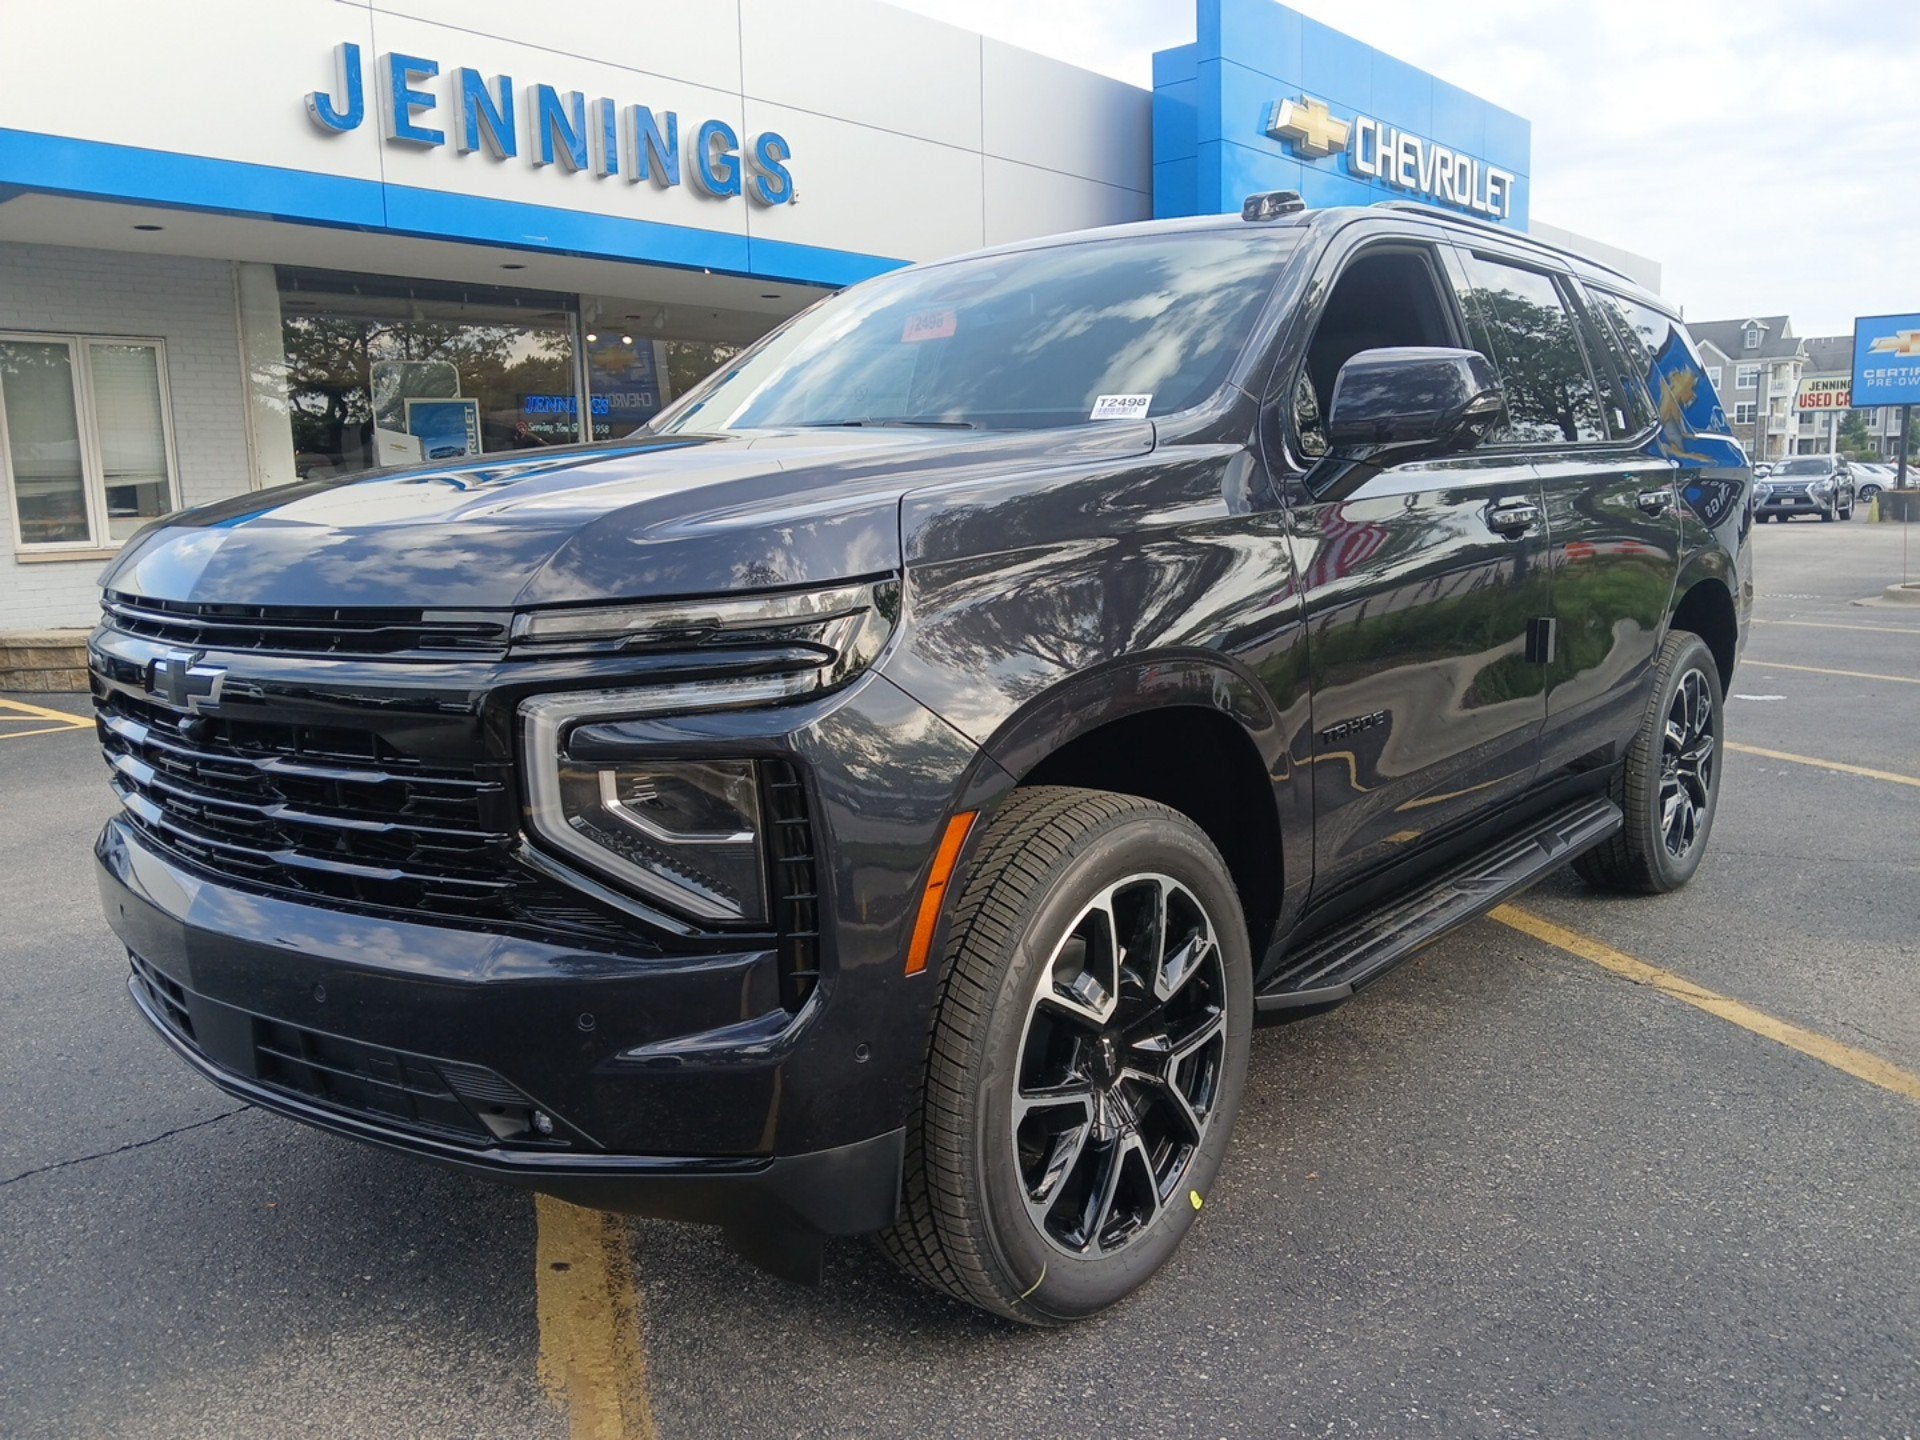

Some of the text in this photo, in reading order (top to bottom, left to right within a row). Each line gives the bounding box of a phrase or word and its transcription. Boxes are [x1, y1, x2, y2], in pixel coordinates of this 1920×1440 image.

[304, 41, 794, 207] JENNINGS
[1355, 115, 1516, 219] CHEVROLET
[524, 396, 609, 414] JENNIGS
[1100, 398, 1148, 408] T2498
[1799, 393, 1832, 408] USED
[528, 422, 554, 434] Serving
[556, 422, 569, 433] You
